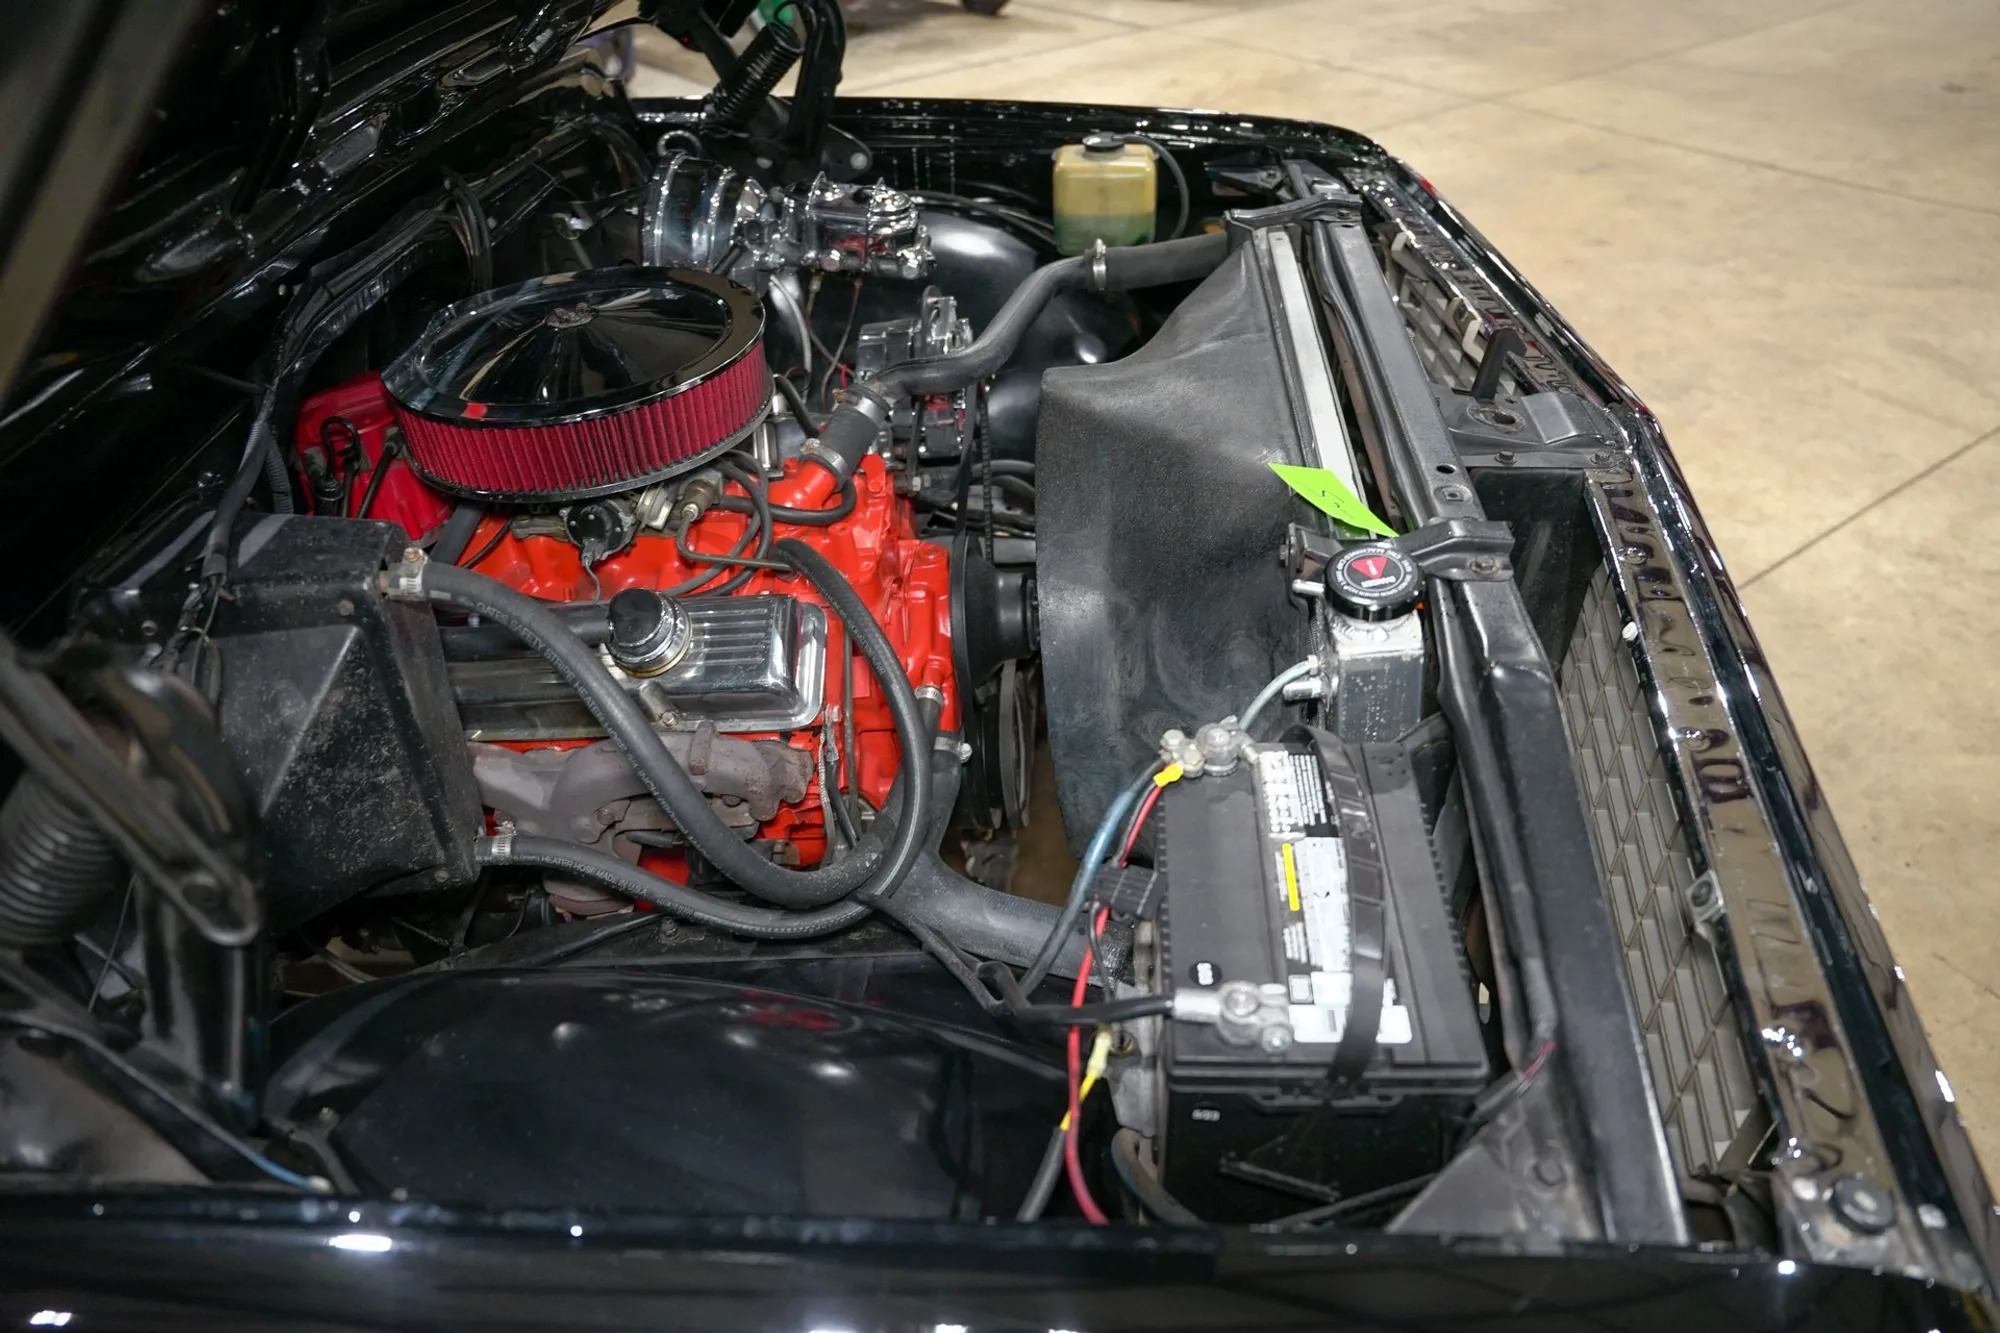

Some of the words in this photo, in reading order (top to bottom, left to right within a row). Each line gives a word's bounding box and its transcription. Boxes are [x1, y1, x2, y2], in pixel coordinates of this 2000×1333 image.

[476, 602, 509, 624] GATES
[510, 619, 546, 650] SAFETY
[543, 647, 576, 680] STRIPE
[541, 855, 573, 868] HEATER
[573, 862, 597, 875] HOSE
